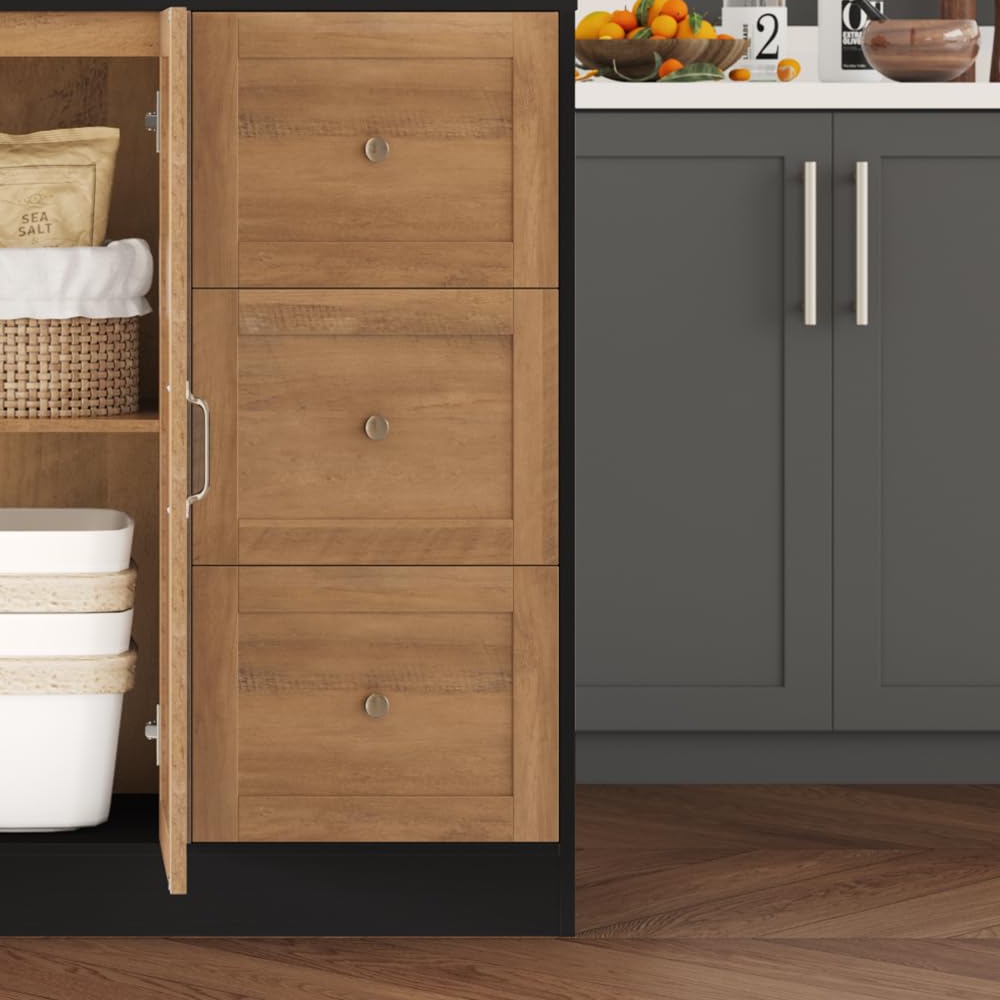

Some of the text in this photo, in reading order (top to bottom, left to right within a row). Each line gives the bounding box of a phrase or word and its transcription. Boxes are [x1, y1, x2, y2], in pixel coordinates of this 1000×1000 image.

[756, 13, 779, 60] 2
[21, 212, 48, 224] SEA
[18, 223, 53, 237] SALT
